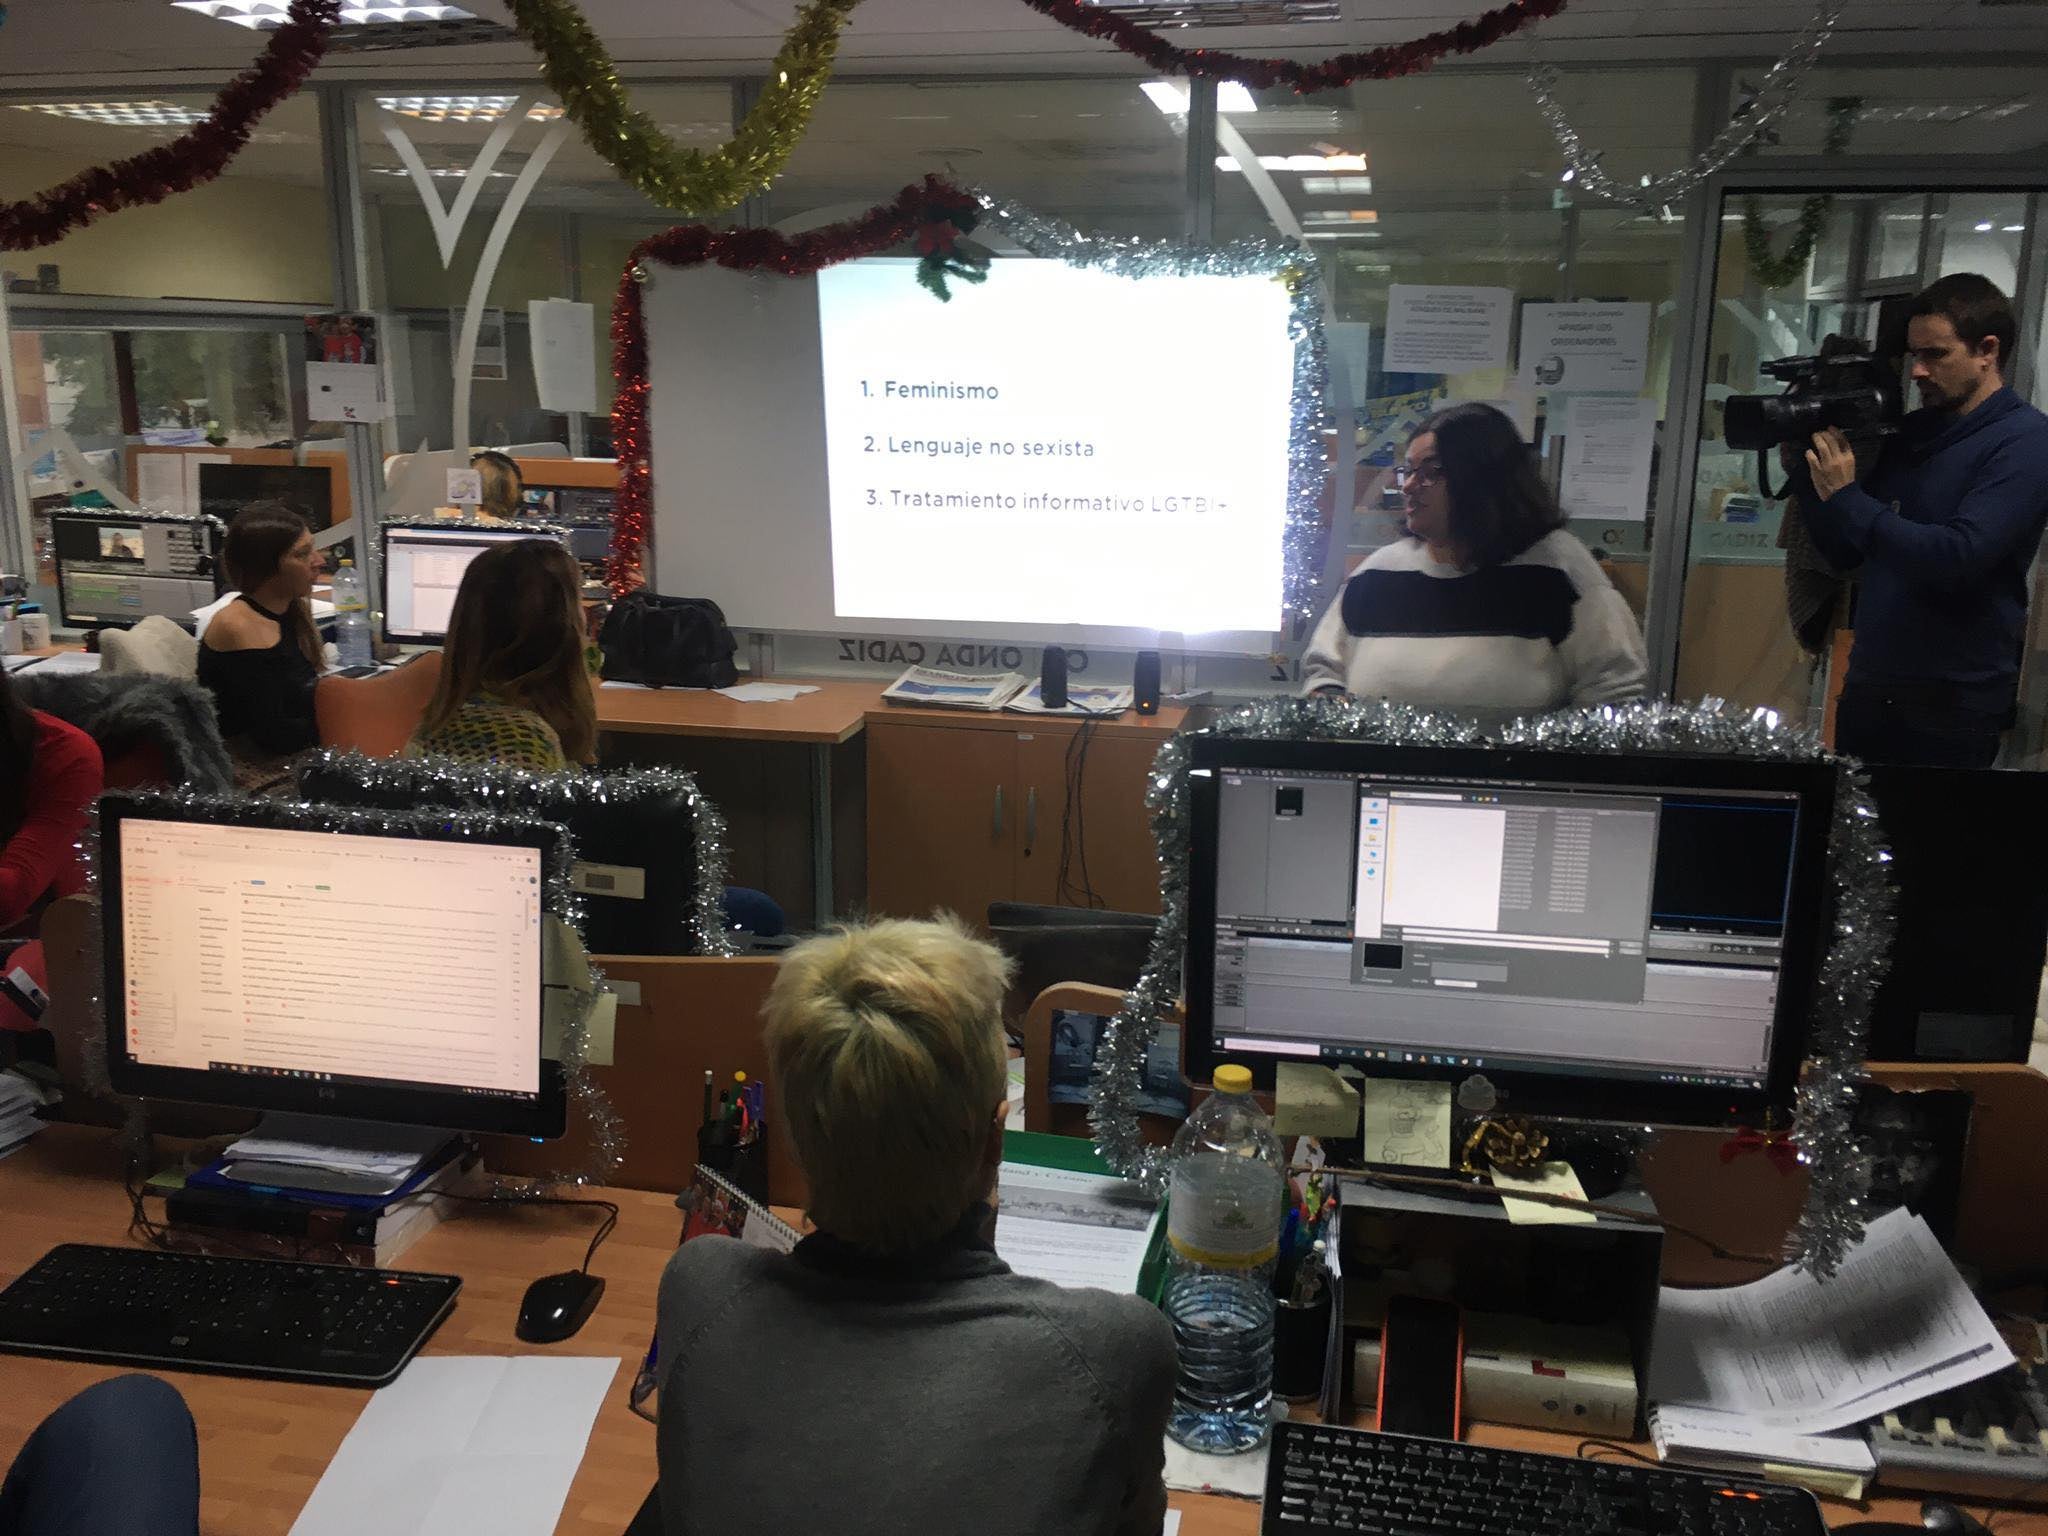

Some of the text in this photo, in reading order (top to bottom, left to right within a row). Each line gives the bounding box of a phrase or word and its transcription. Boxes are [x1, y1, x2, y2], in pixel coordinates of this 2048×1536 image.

[860, 379, 999, 401] 1. Feminismo
[863, 435, 1094, 458] 2. Lenguaje no sexista
[865, 488, 883, 506] 3.
[890, 489, 1017, 510] Tratamiento
[1023, 491, 1145, 512] informativo
